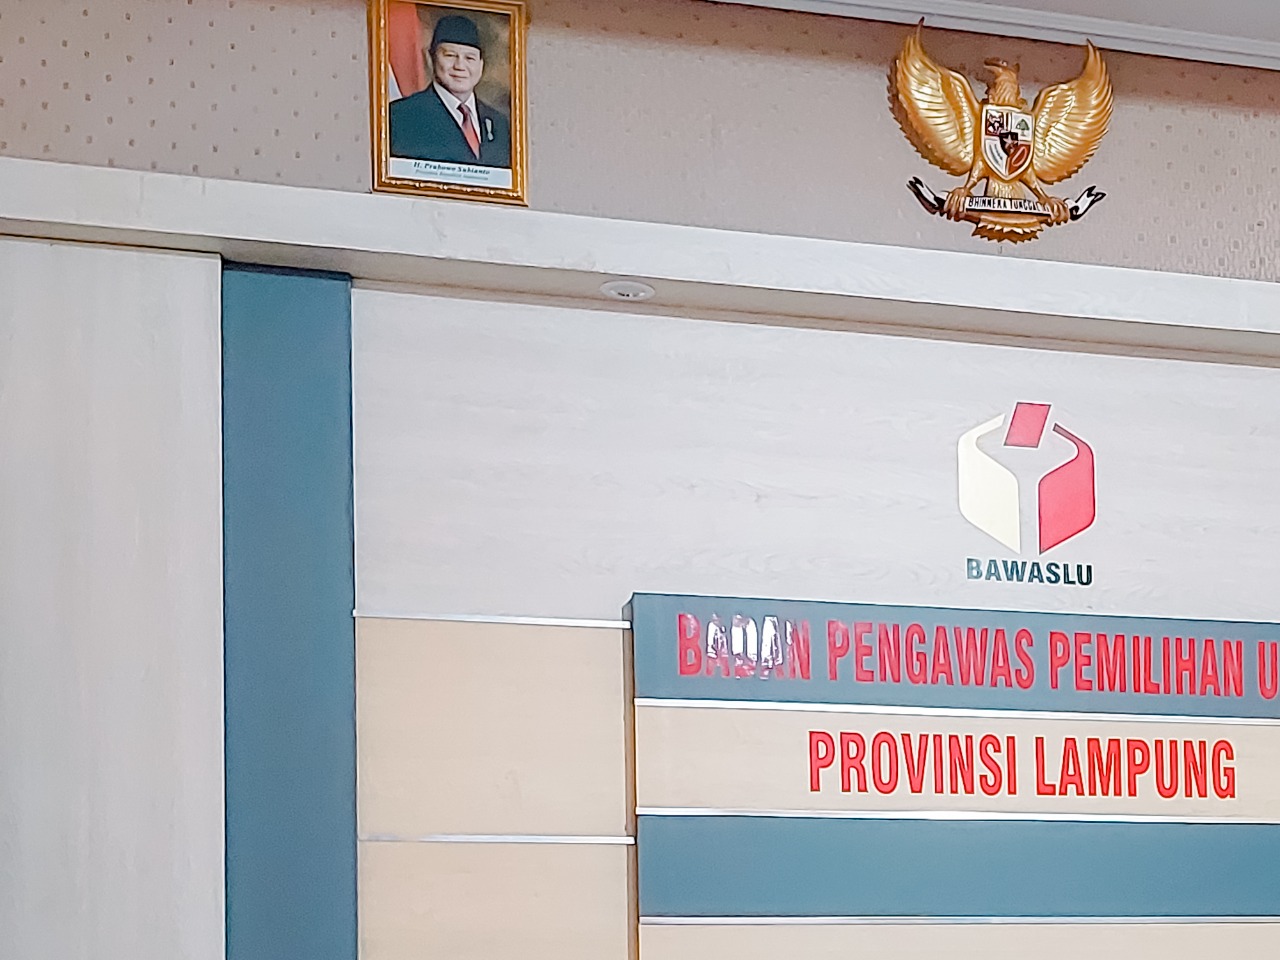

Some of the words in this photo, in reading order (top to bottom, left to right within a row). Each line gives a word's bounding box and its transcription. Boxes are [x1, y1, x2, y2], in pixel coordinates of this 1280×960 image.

[966, 558, 1093, 586] BAWASLU
[678, 613, 811, 680] BADAN
[827, 619, 1035, 690] PENGAWAS
[1050, 631, 1243, 697] PEMILIHAN
[808, 730, 1017, 796] PROVINSI
[1035, 736, 1236, 799] LAMPUNG
